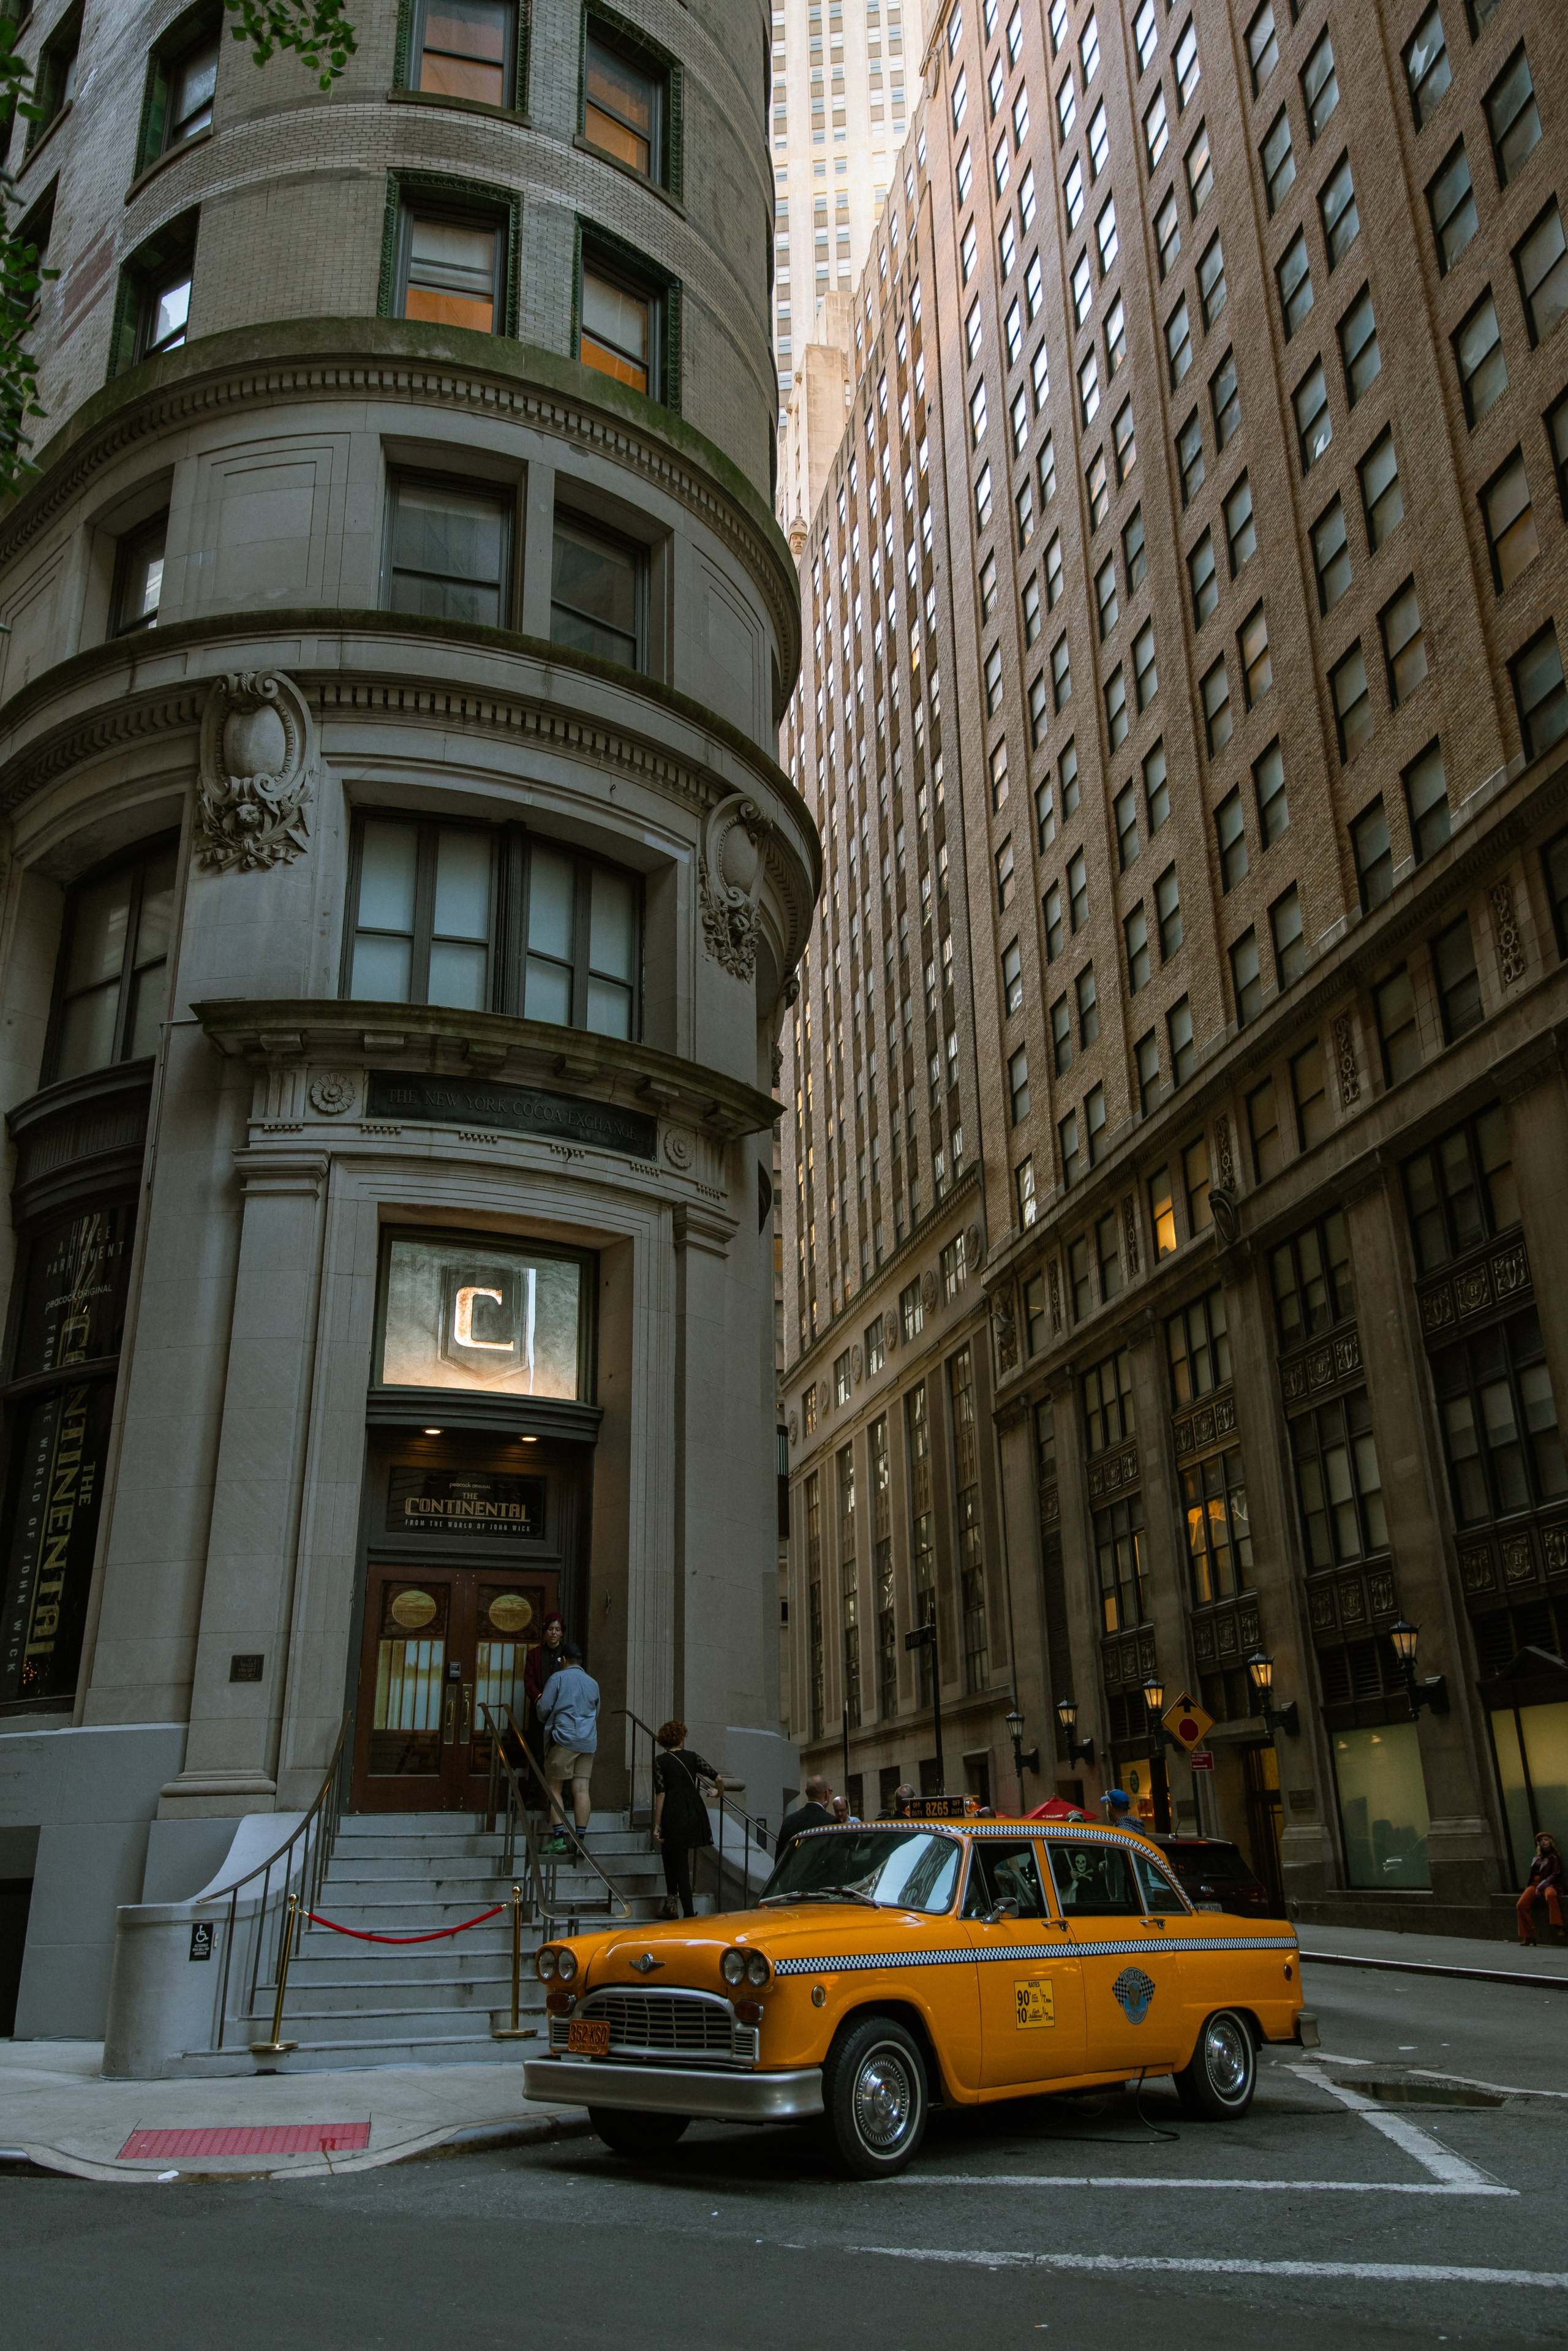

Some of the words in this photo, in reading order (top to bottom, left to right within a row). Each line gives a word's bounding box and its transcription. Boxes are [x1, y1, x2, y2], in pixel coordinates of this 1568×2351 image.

[388, 1089, 417, 1104] THE
[424, 1091, 459, 1108] NEW
[465, 1095, 507, 1114] YORK
[513, 1101, 563, 1123] COCOA
[567, 1111, 637, 1141] EXCHANGE
[46, 1255, 73, 1277] PART
[81, 1241, 124, 1265] EVENT
[45, 1291, 75, 1315] peacock
[77, 1284, 113, 1300] ORIGINAL
[454, 1286, 514, 1351] C
[43, 1324, 56, 1372] FROM
[32, 1437, 49, 1502] WORLD
[78, 1460, 96, 1506] THE
[27, 1517, 37, 1539] OF
[405, 1497, 531, 1522] CONTINENTAL
[17, 1554, 32, 1604] JOHN
[7, 1619, 23, 1672] WICK
[925, 1801, 949, 1817] 8Z65
[1123, 1969, 1142, 1983] CHECKER
